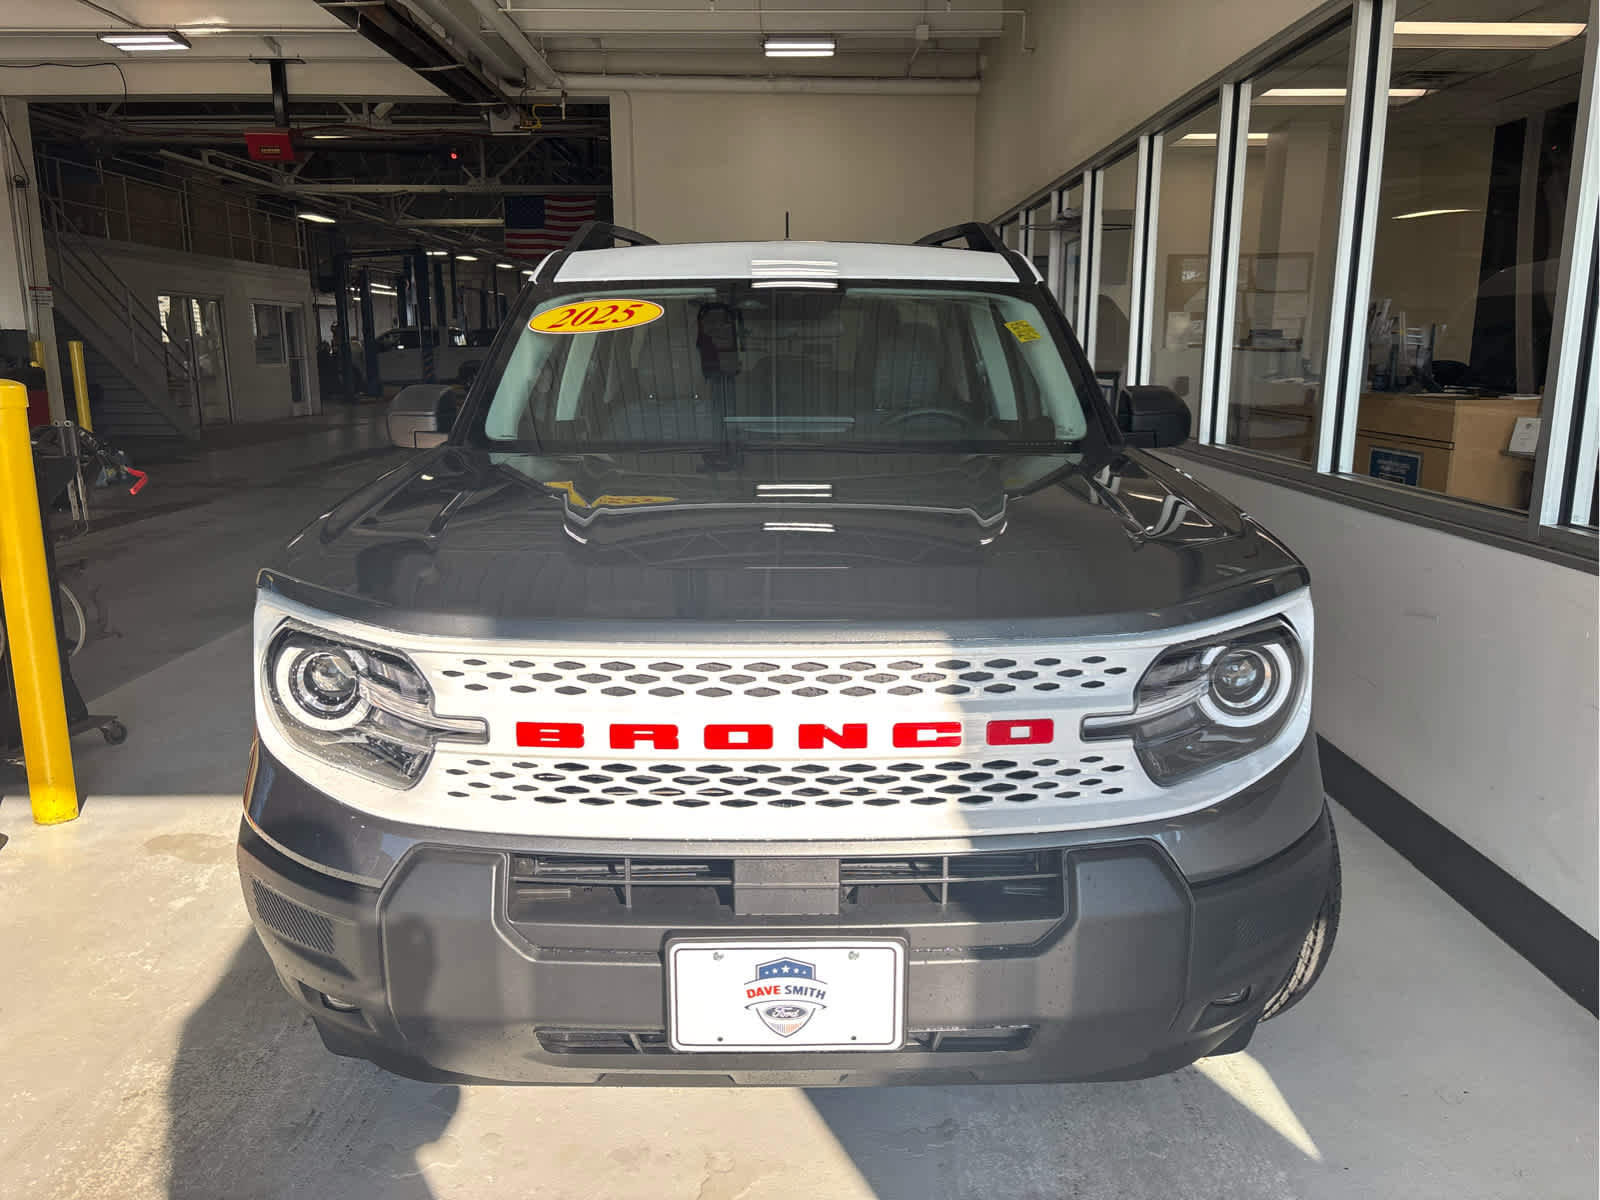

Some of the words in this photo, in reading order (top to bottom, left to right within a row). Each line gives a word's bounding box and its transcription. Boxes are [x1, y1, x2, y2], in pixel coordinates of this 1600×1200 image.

[547, 304, 644, 329] 2025
[516, 718, 1054, 750] BRONCO
[746, 985, 781, 999] DAVE
[784, 985, 826, 1000] SMITH
